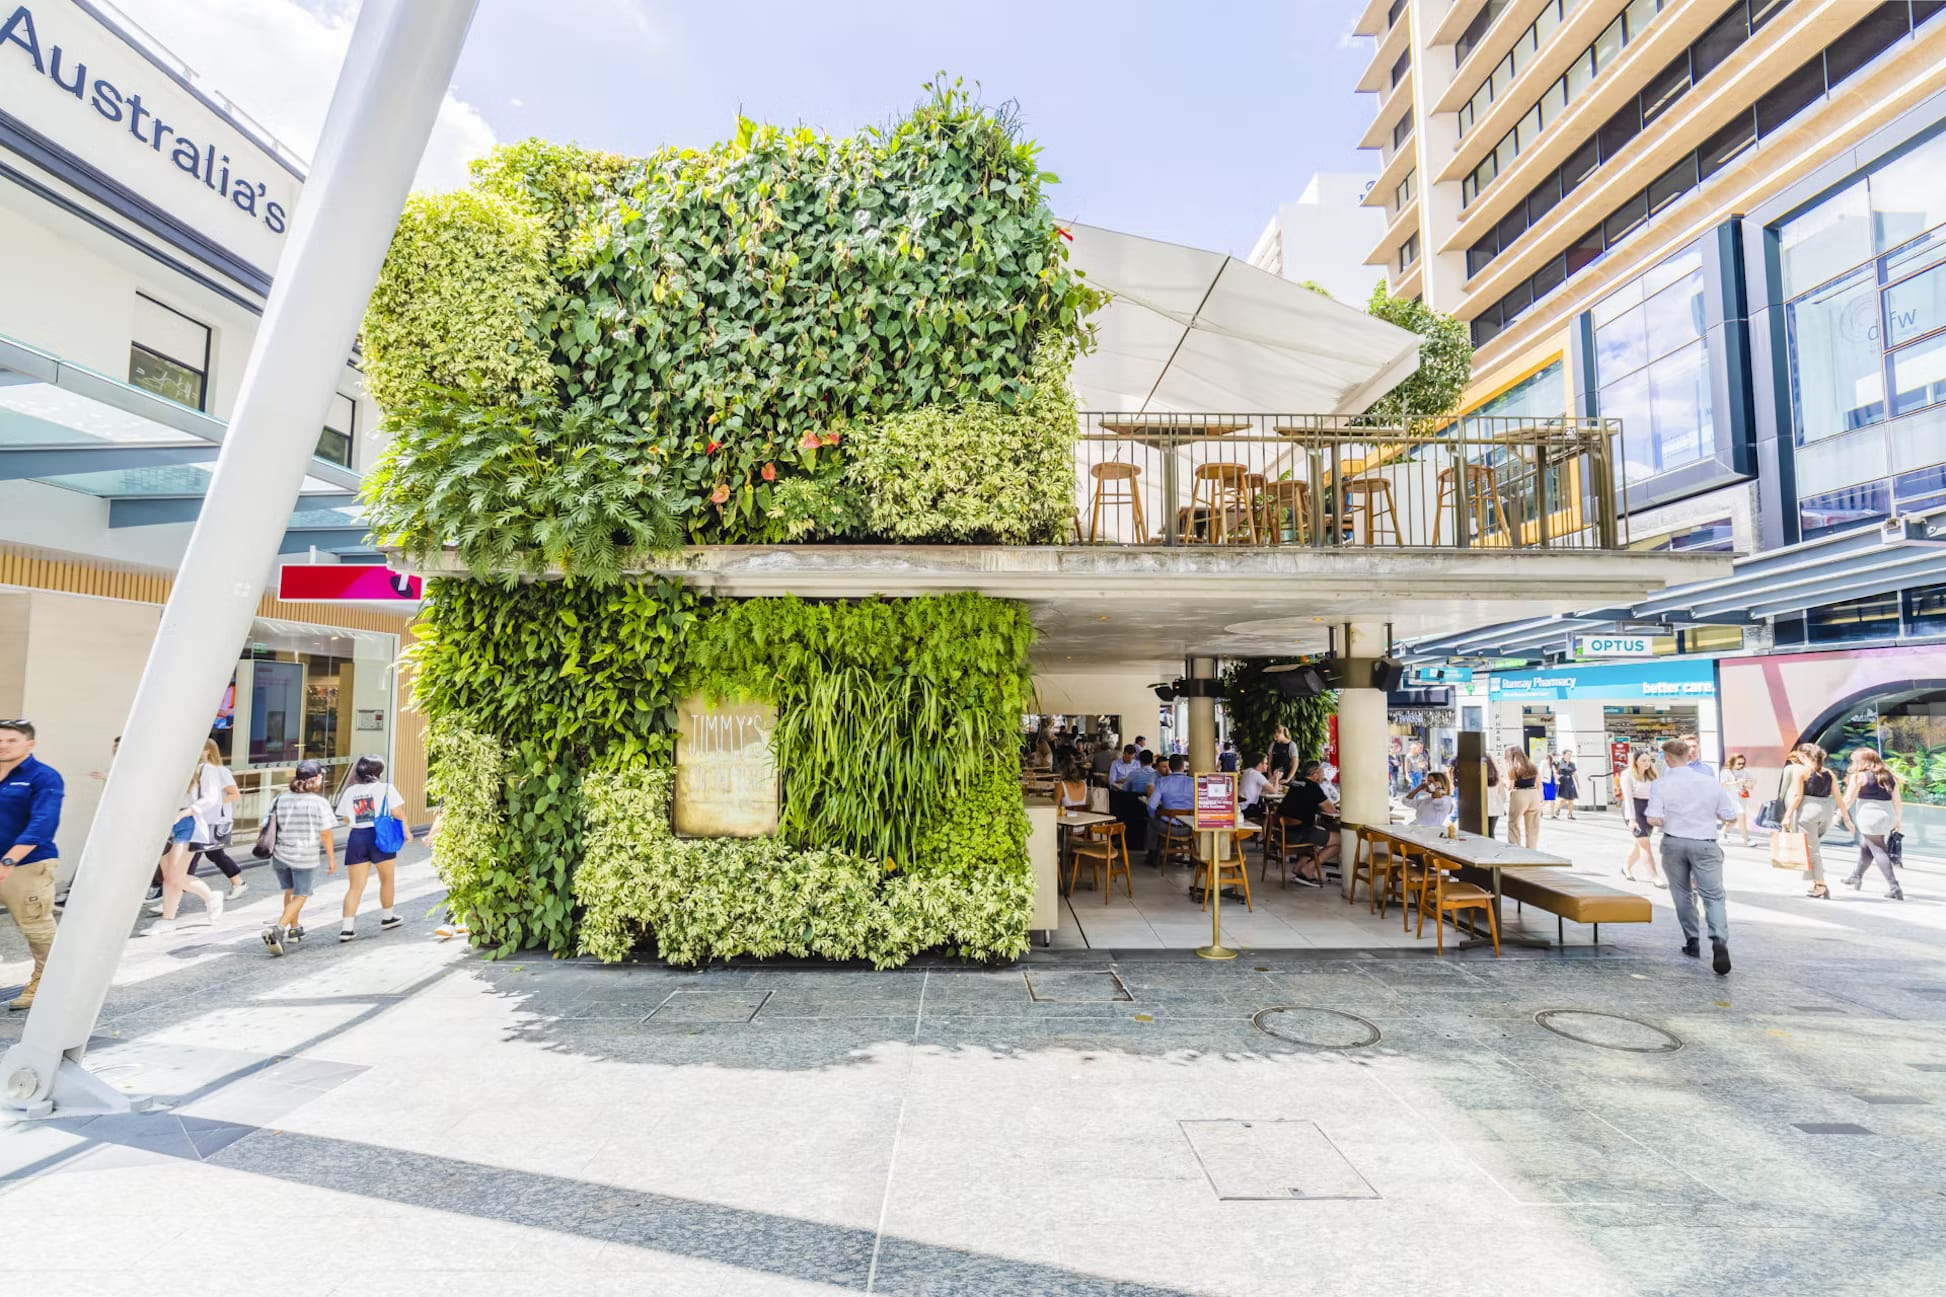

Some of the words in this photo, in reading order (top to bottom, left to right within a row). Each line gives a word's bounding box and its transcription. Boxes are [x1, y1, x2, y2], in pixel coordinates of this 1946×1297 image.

[0, 5, 286, 234] Australia's
[1591, 640, 1644, 651] OPTUS
[1534, 677, 1576, 688] Pharmacy
[1643, 682, 1680, 693] better
[689, 714, 763, 756] JIMMY'S
